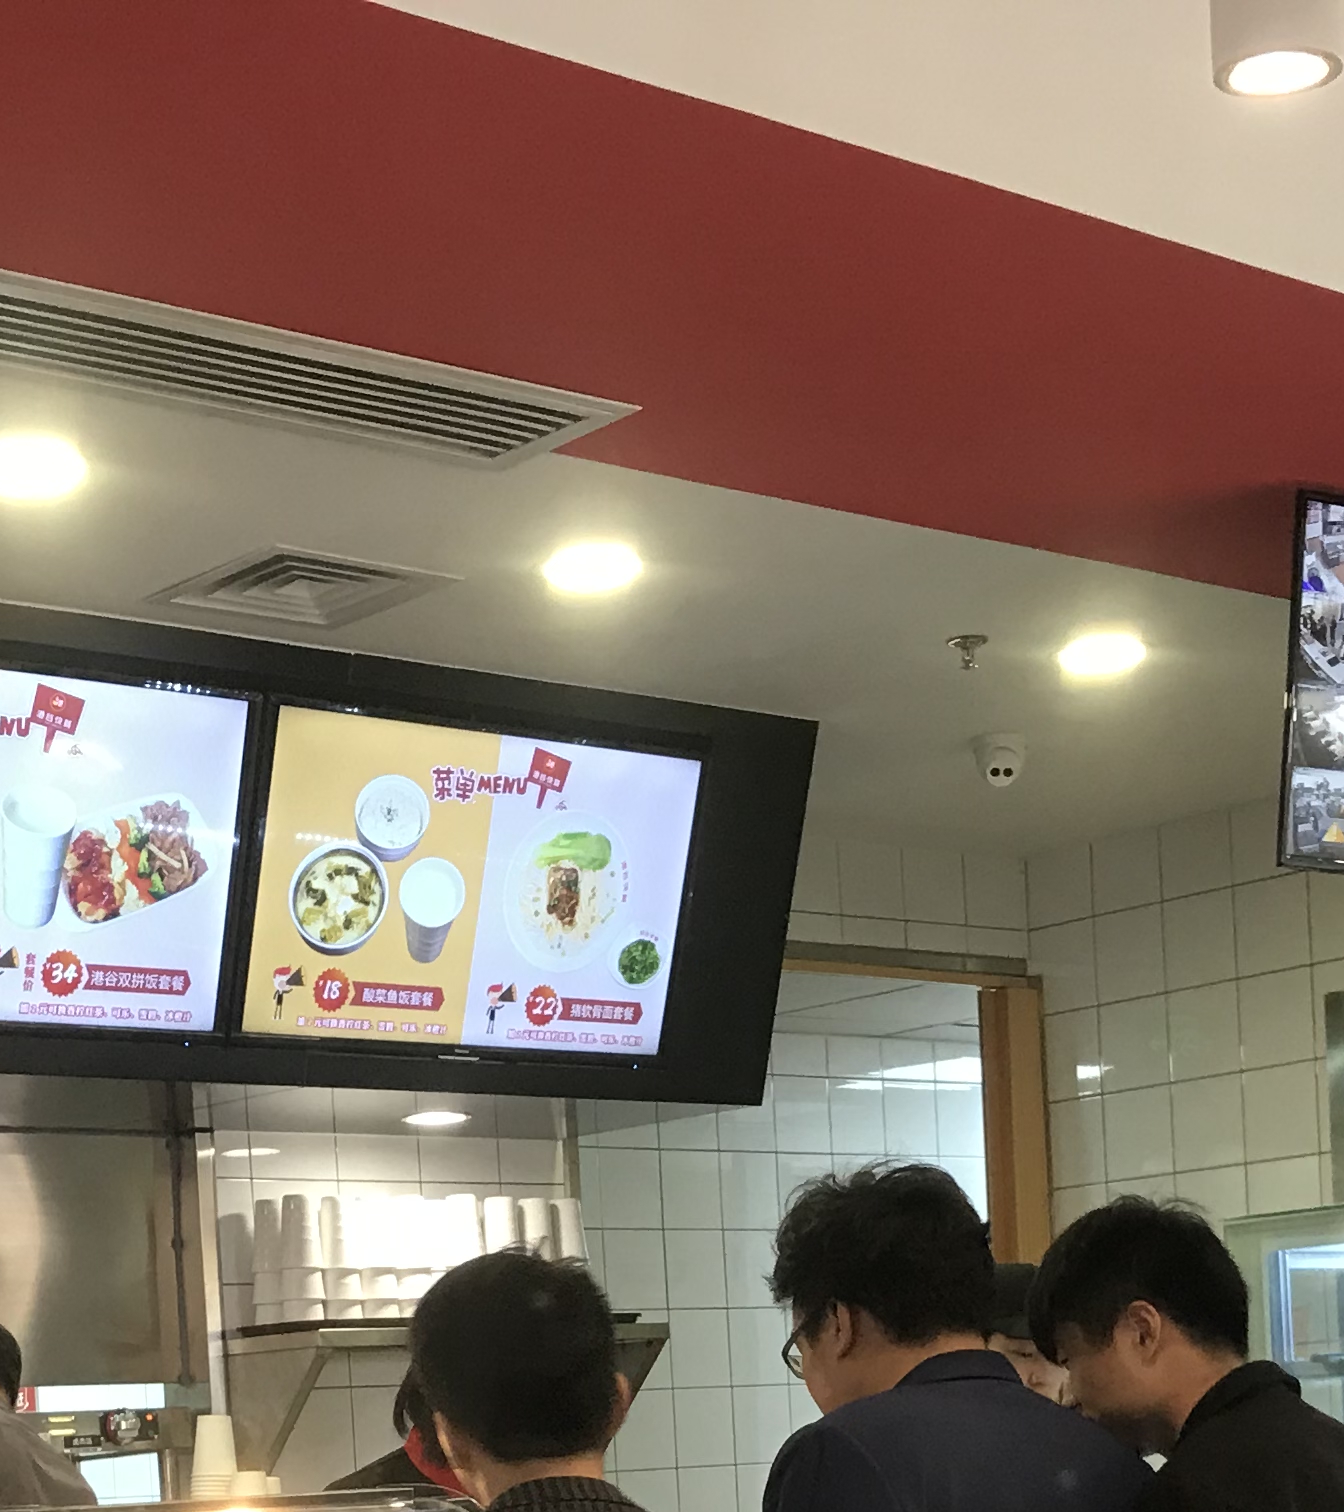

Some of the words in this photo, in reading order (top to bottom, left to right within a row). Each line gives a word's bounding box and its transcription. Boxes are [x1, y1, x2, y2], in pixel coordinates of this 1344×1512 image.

[90, 970, 185, 992] 港谷双拼饭套餐
[361, 987, 434, 1007] 酸菜鱼饭套餐
